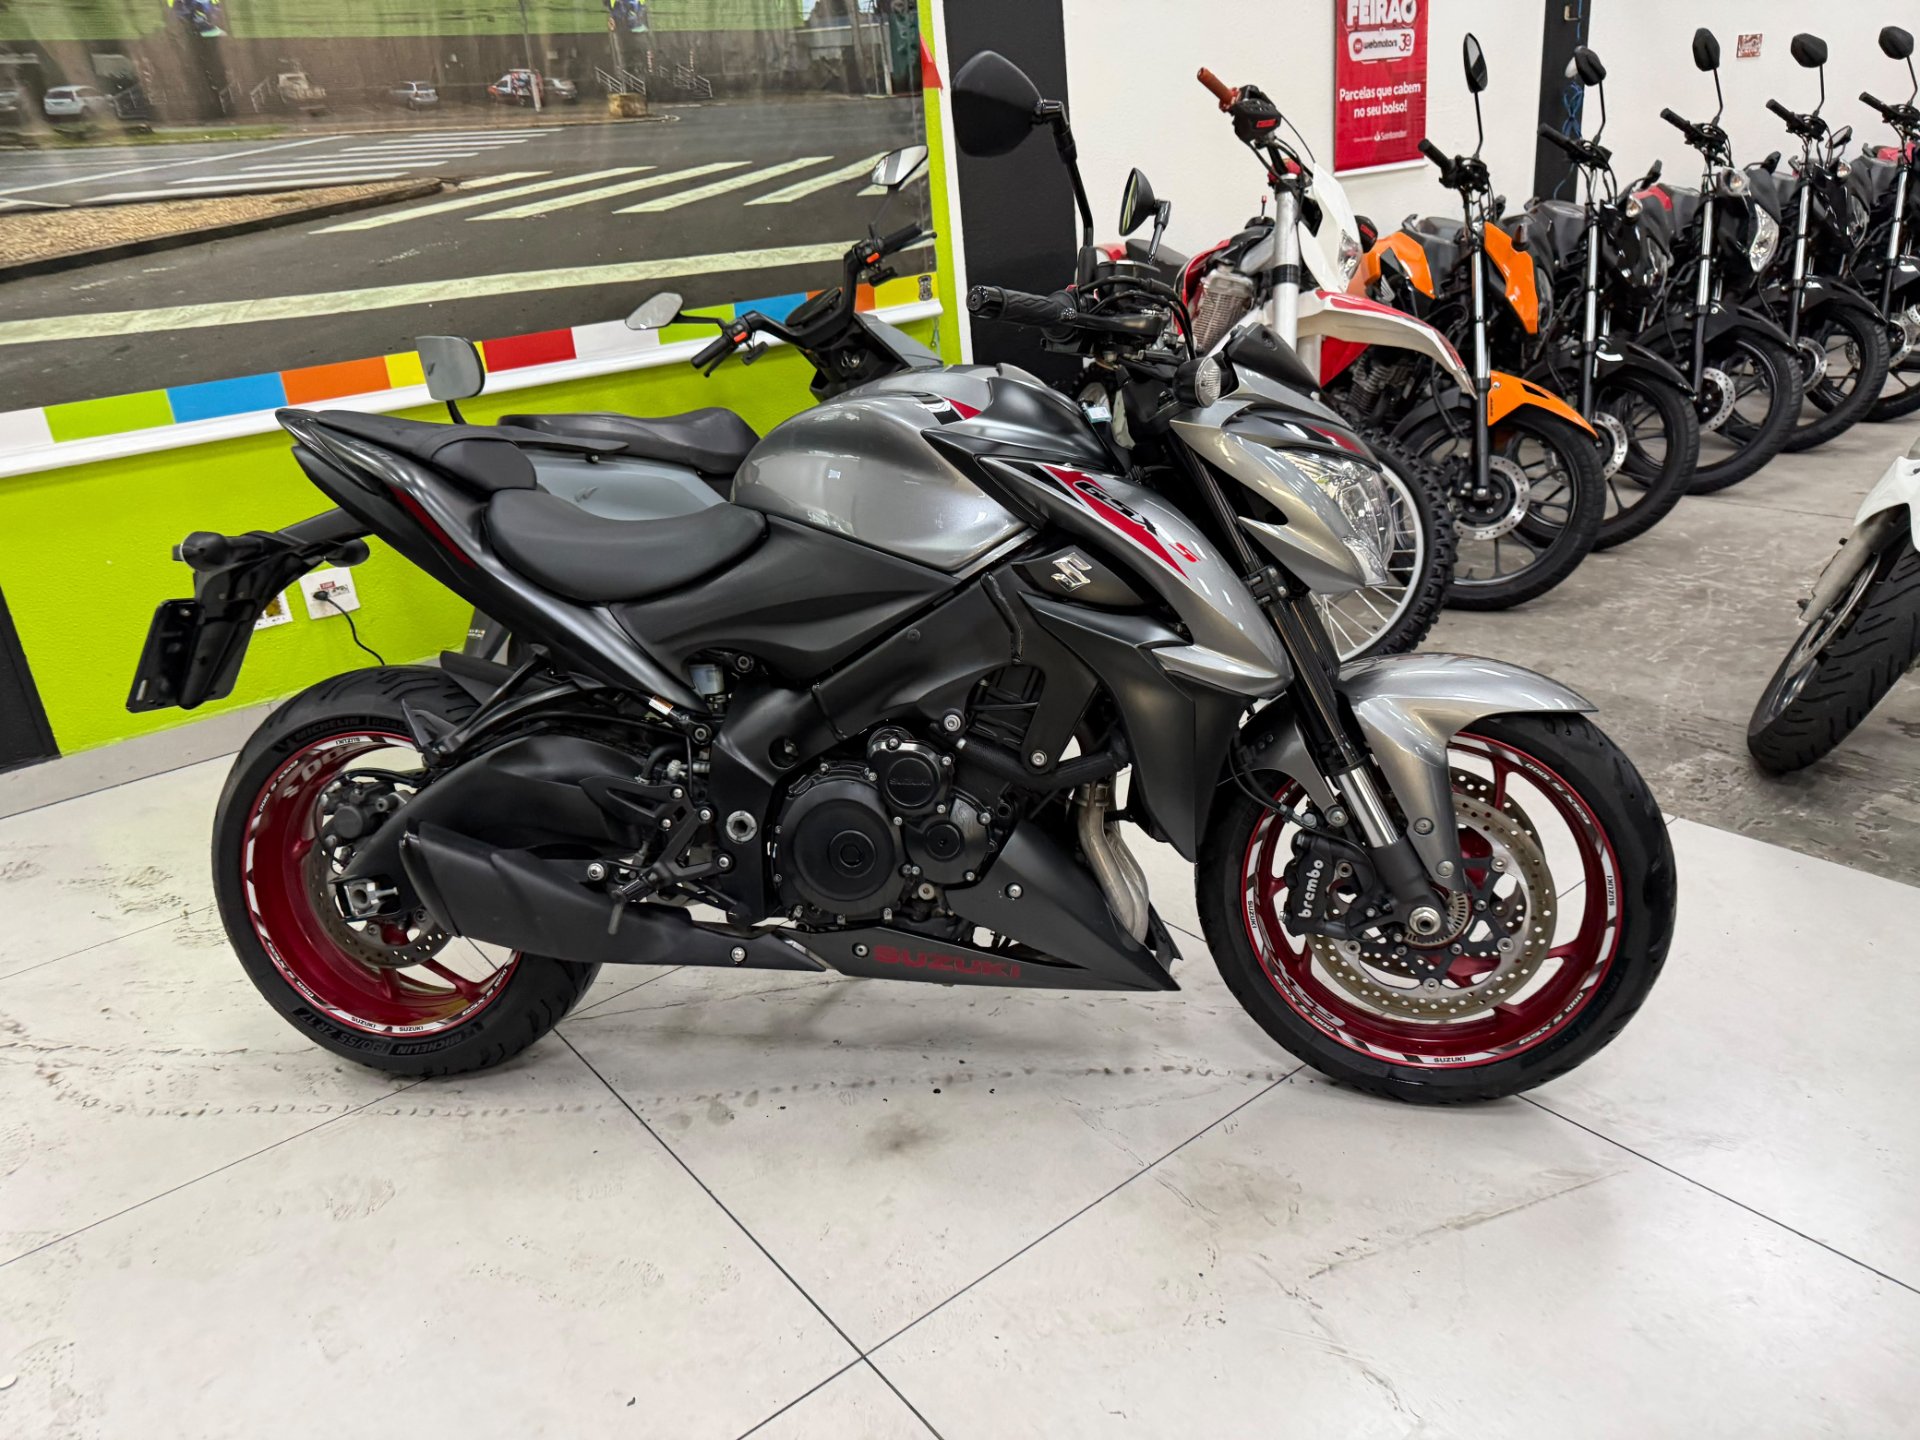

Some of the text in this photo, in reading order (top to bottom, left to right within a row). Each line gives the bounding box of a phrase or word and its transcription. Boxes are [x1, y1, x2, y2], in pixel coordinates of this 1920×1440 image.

[1364, 38, 1398, 50] webmotors
[1339, 81, 1421, 102] Parcelas que cabem
[1353, 99, 1408, 118] no seu bolso!
[1072, 480, 1159, 537] GSX
[1297, 859, 1324, 918] brembo
[1606, 875, 1615, 907] SUZUKI
[1247, 900, 1257, 929] SUZUKI
[874, 944, 1021, 979] SUZUKI
[350, 1016, 378, 1029] SUZUKI
[397, 1032, 463, 1055] MICHELIN
[1433, 1056, 1467, 1064] SUZUKI
